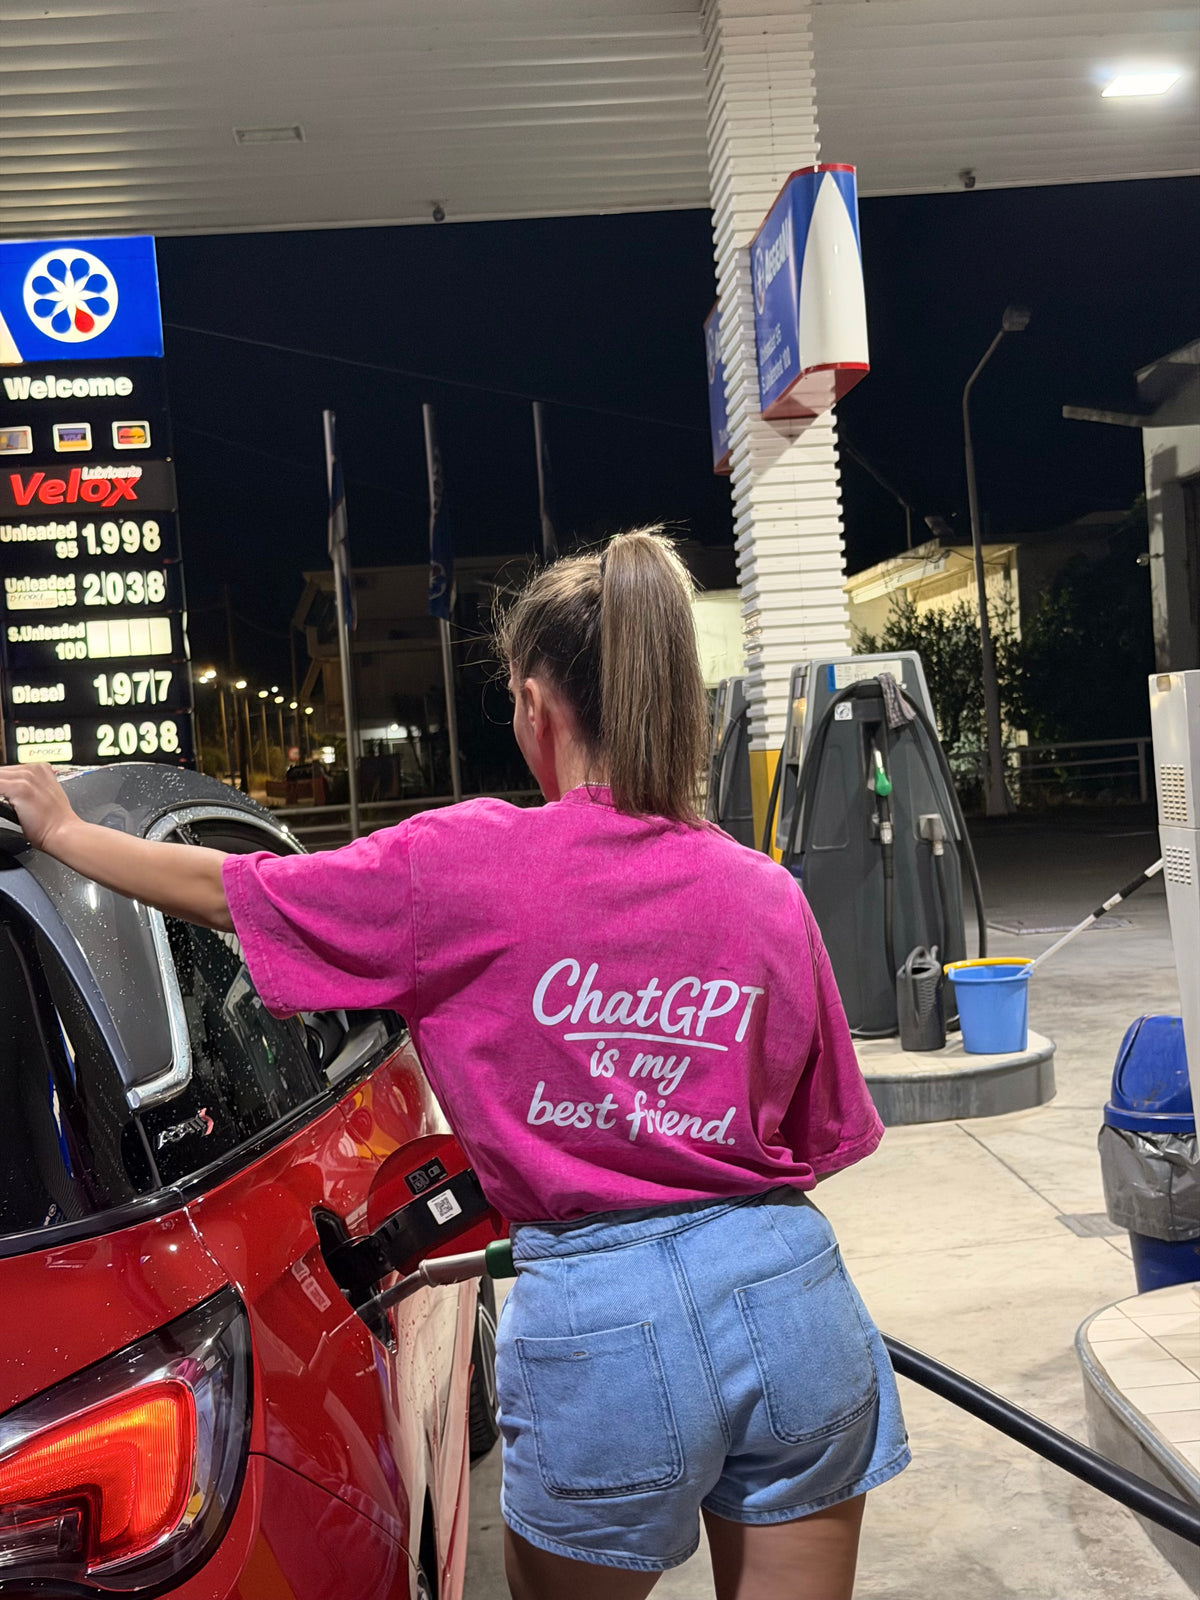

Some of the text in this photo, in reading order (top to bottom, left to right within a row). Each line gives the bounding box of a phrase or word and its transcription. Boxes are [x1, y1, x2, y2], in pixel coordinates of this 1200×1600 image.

[3, 375, 133, 400] Welcome
[9, 467, 140, 507] Velox
[0, 520, 78, 543] Unleaded
[82, 520, 161, 555] 1.998
[55, 540, 79, 559] 95
[4, 573, 76, 593] Unleaded
[57, 590, 77, 607] 95
[7, 621, 86, 642] S.Unleaded
[55, 641, 87, 660] 100
[12, 683, 65, 704] Diesel
[93, 671, 172, 706] 1.977
[15, 724, 71, 744] Diesel
[532, 958, 764, 1042] ChatGPT
[590, 1041, 690, 1095] is my
[526, 1081, 736, 1145] best friend.
